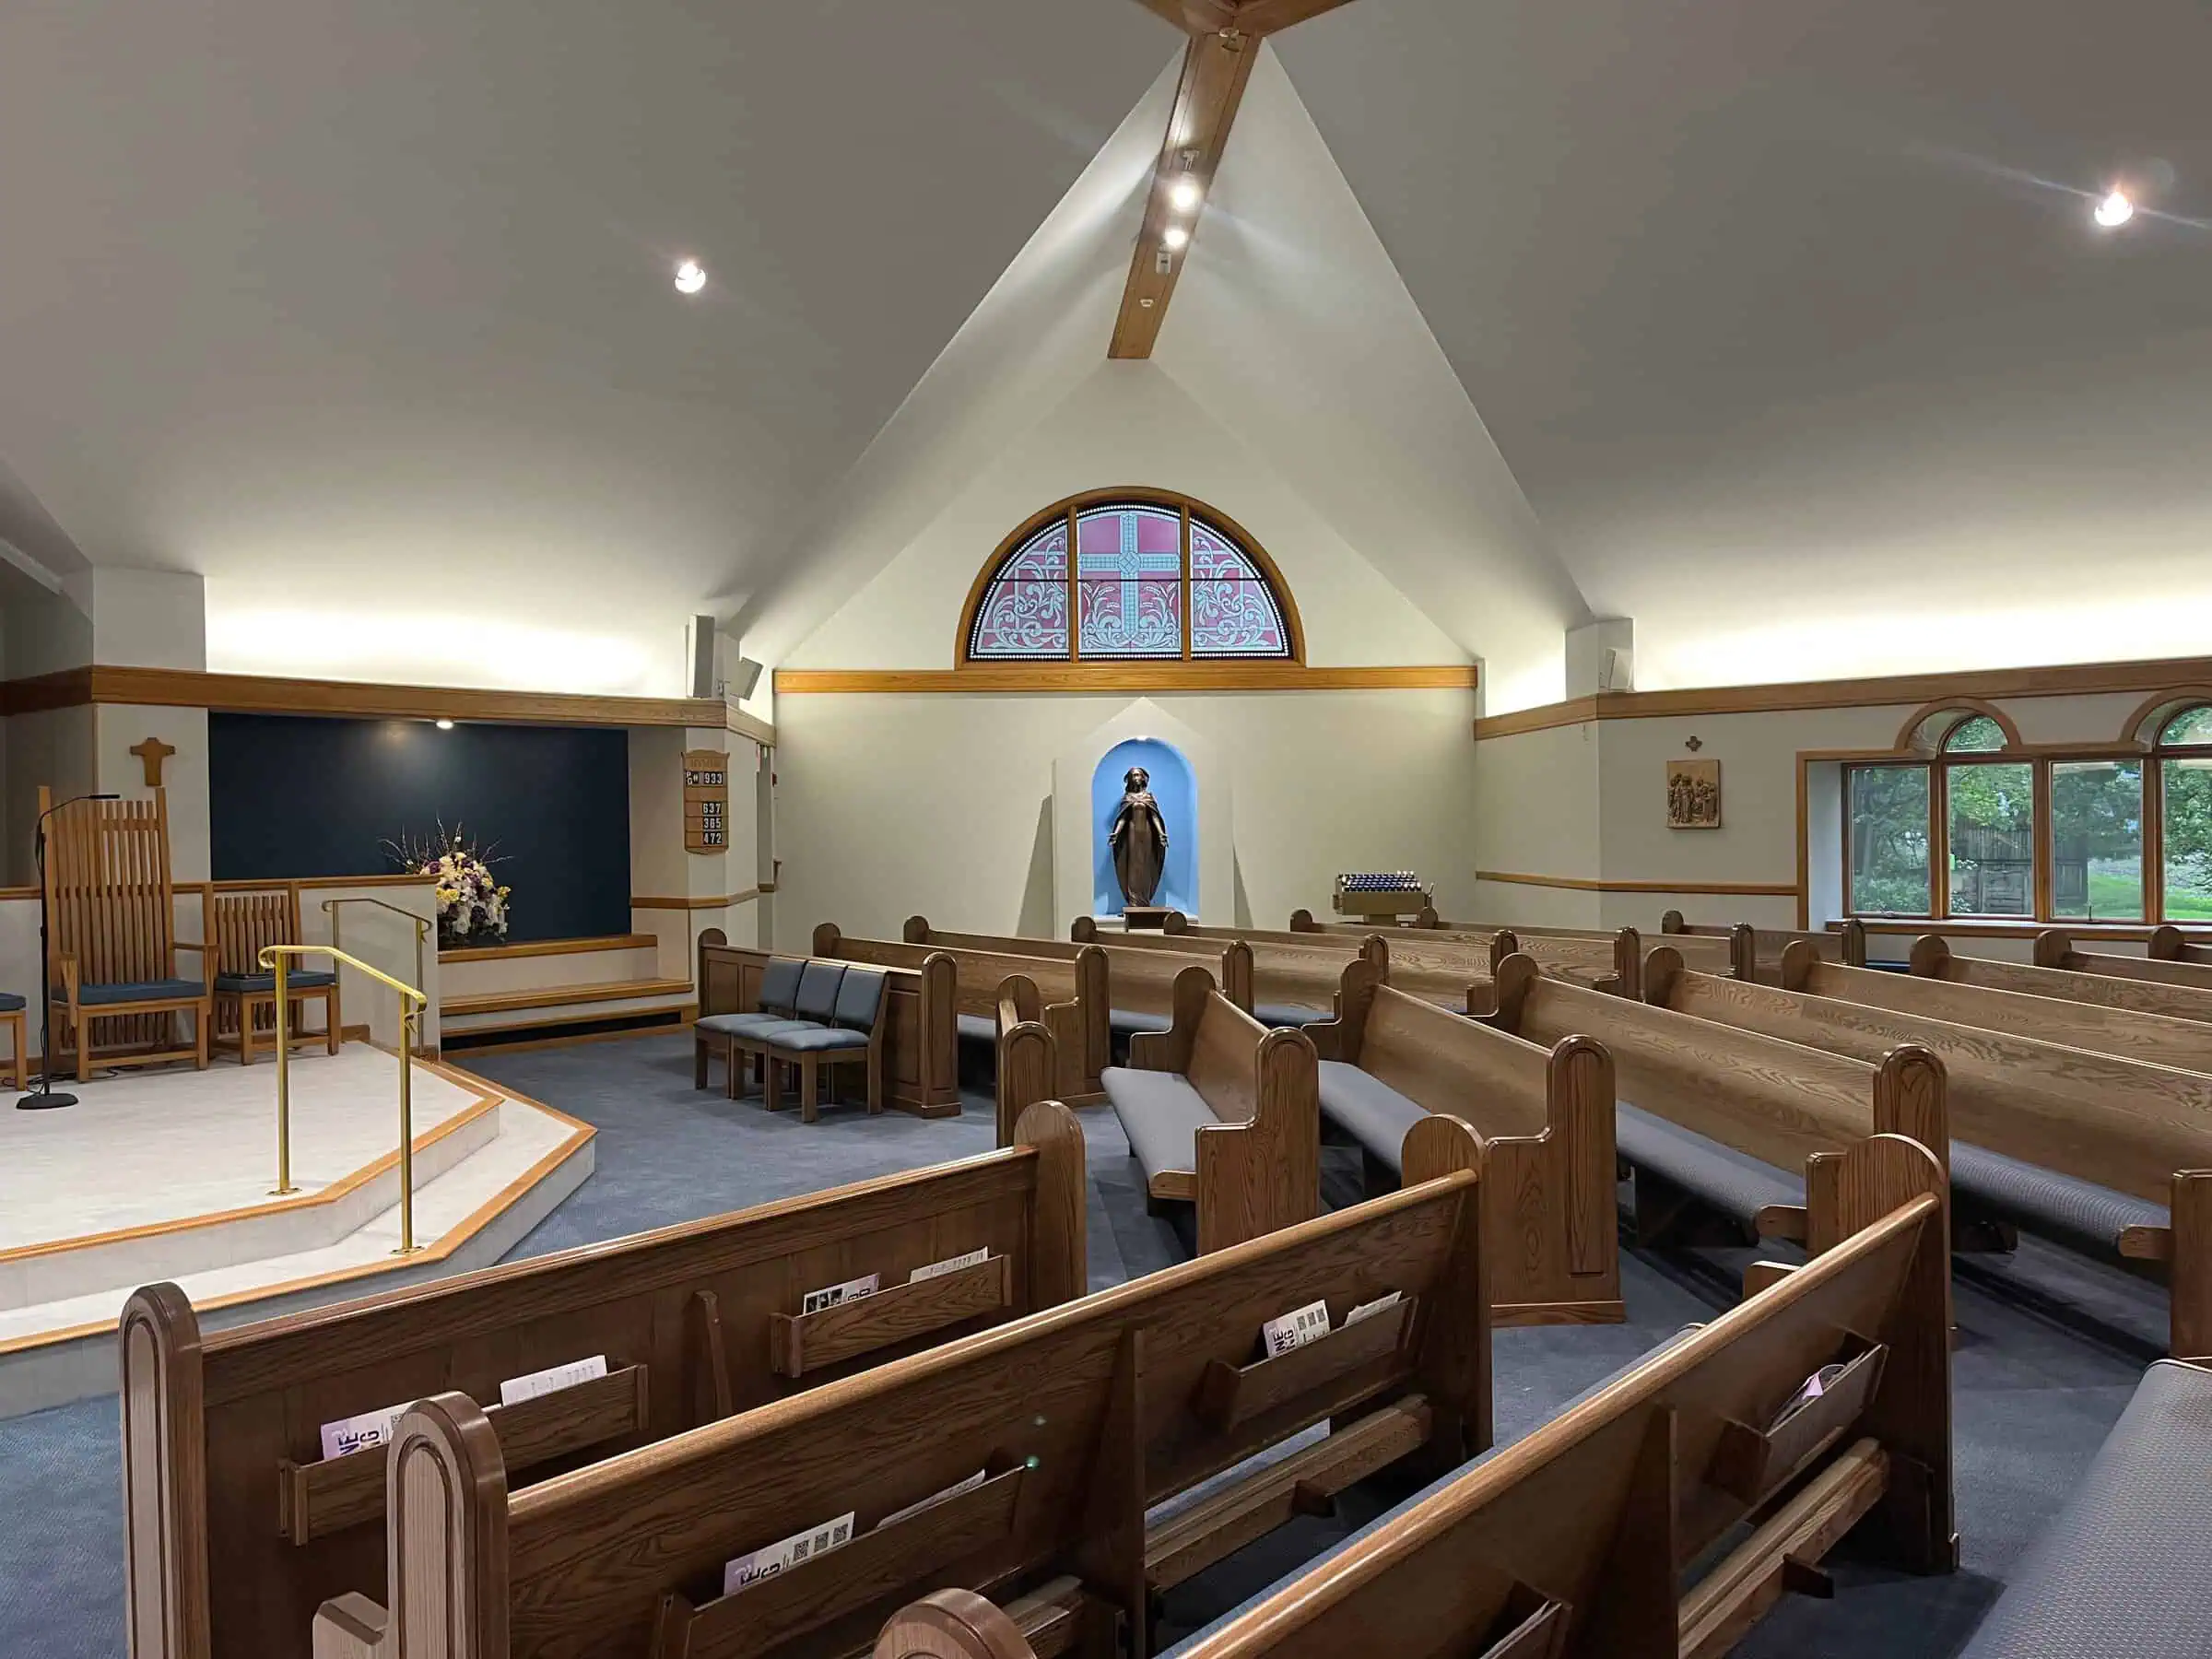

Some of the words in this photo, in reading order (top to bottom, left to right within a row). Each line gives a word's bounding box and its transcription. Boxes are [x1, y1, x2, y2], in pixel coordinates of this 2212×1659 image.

[704, 772, 723, 784] 933
[702, 803, 722, 814] 637
[703, 832, 723, 844] 472
